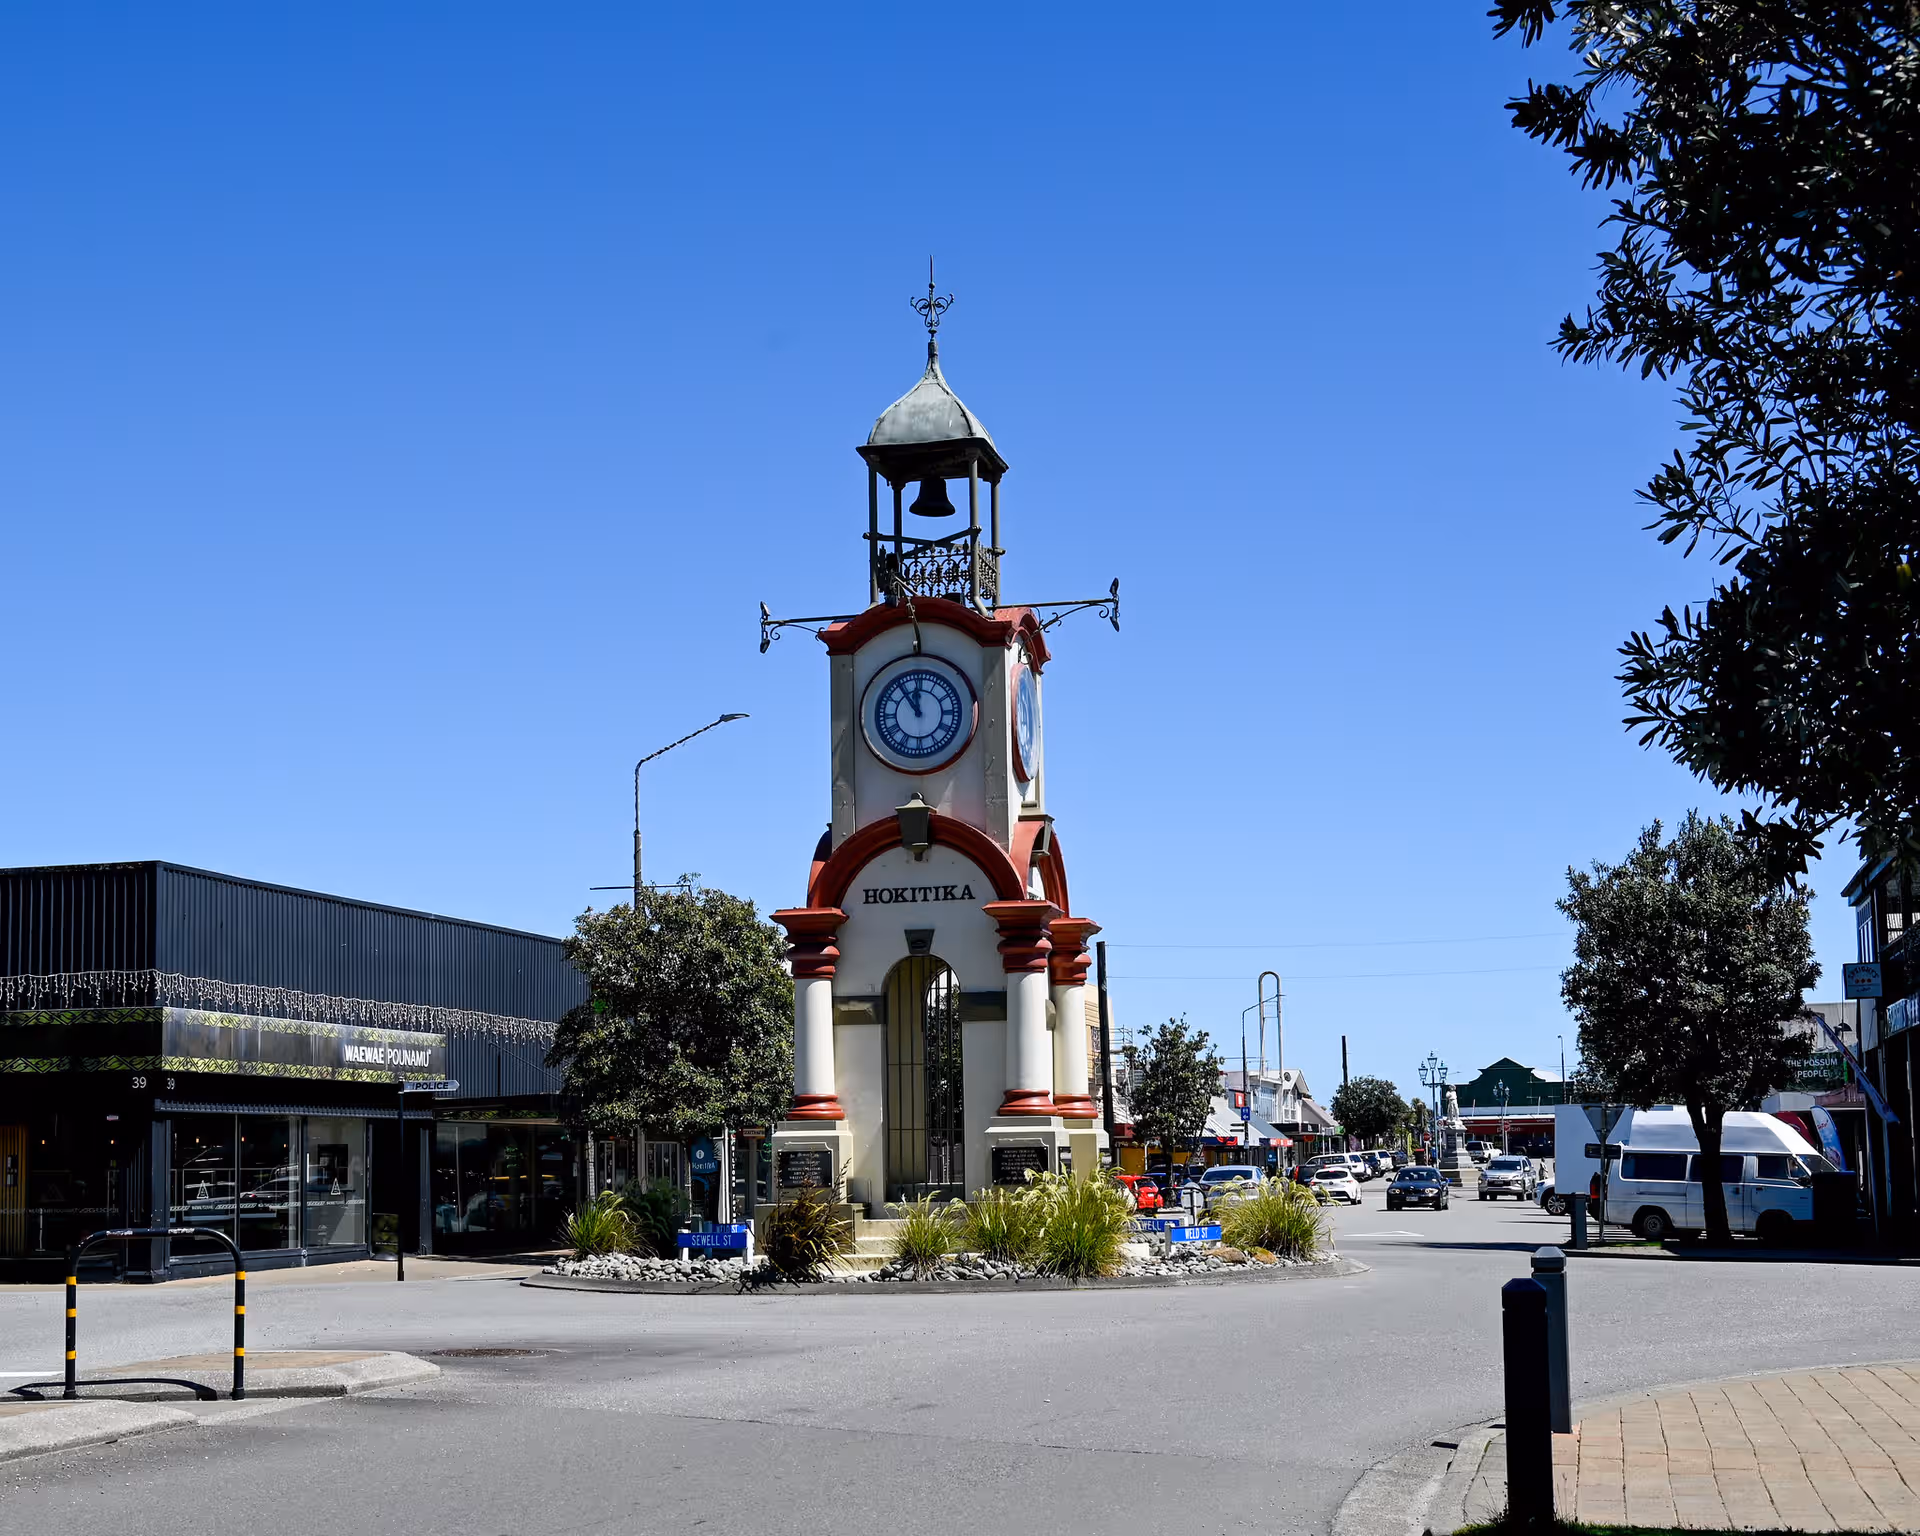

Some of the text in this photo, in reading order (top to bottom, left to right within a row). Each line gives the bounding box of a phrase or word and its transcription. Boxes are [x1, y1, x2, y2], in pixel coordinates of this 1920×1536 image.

[863, 884, 976, 904] HOKITIKA
[344, 1044, 429, 1067] WAEWAE POUNAMU
[1803, 1058, 1838, 1067] POSSUM
[1797, 1069, 1828, 1078] PEOPLE
[132, 1076, 147, 1089] 39
[166, 1077, 175, 1090] 39
[415, 1081, 449, 1090] POLICE
[1184, 1227, 1209, 1240] WELD ST
[691, 1235, 732, 1246] SEWELL ST
